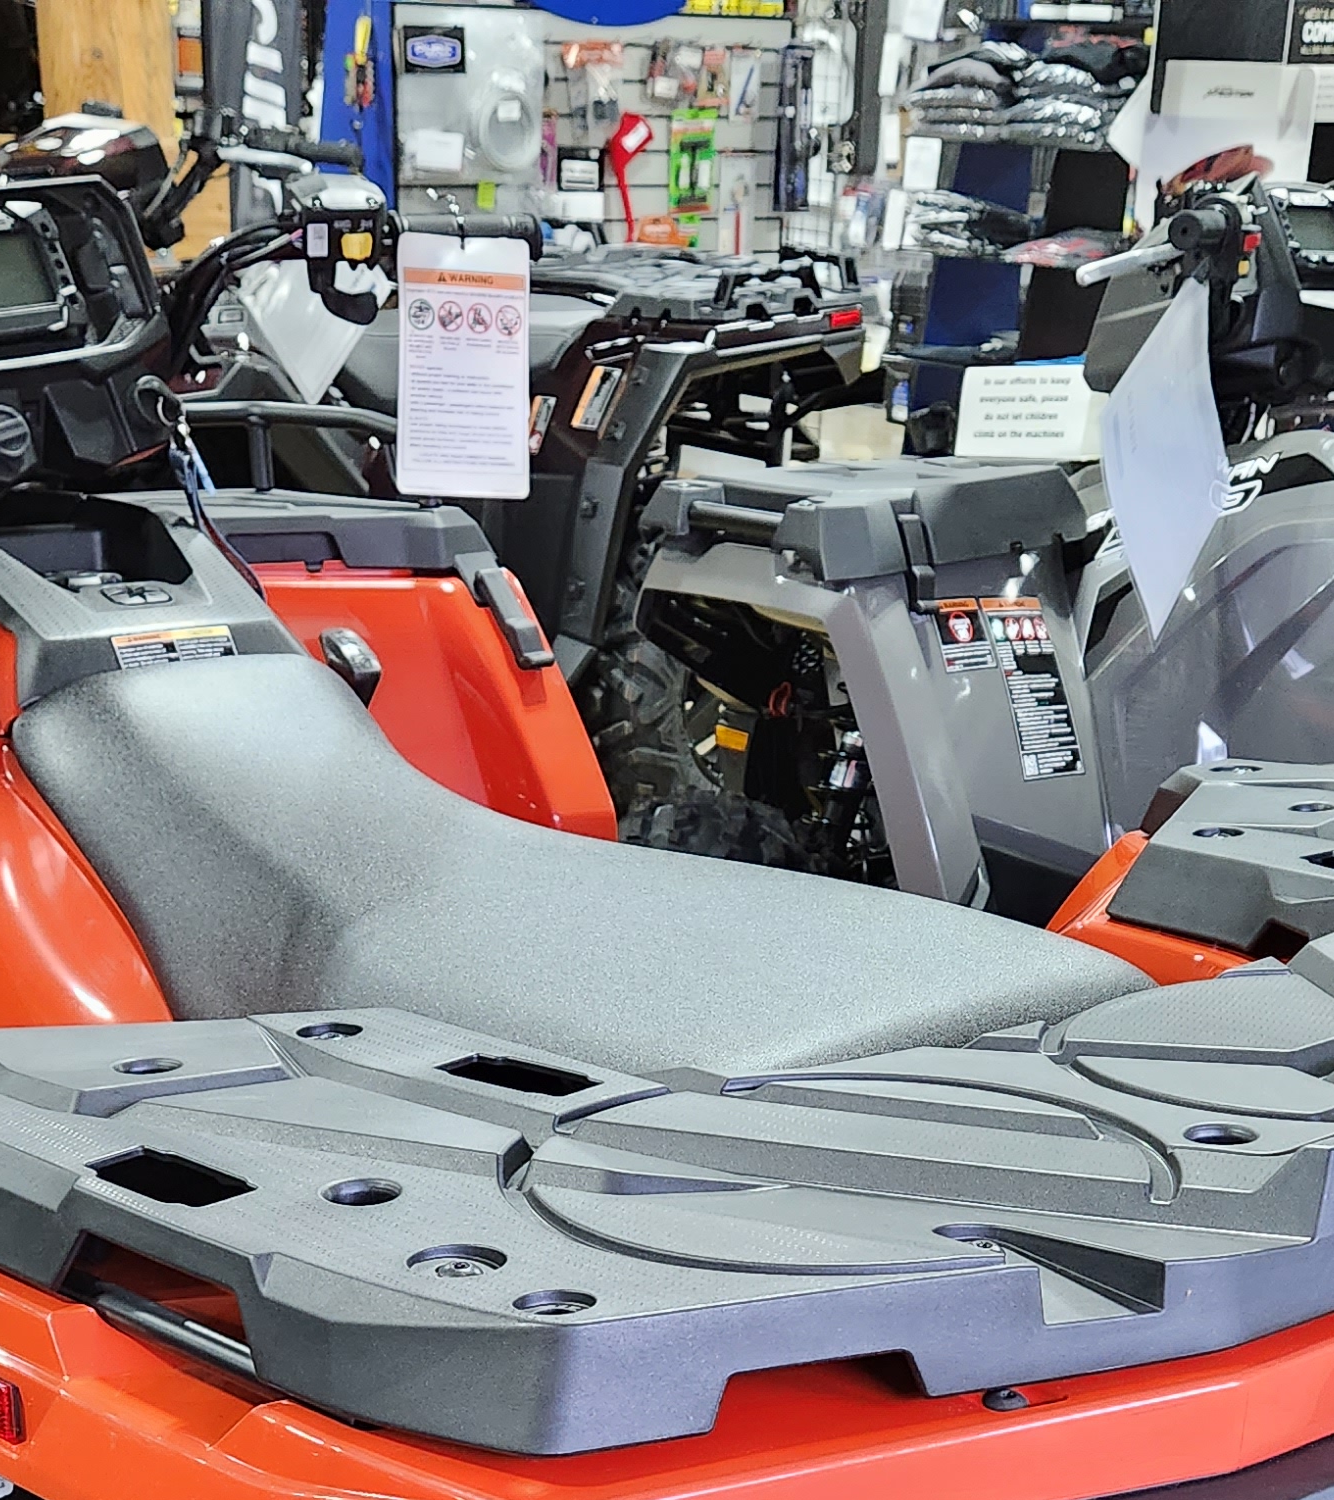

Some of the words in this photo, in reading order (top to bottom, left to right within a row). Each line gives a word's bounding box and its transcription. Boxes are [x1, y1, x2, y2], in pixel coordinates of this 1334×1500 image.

[448, 273, 494, 286] WARNING
[1009, 377, 1037, 386] efforts
[979, 395, 1017, 404] everyone
[1040, 394, 1070, 404] please
[996, 412, 1010, 421] not
[1025, 411, 1059, 421] children
[1025, 429, 1065, 438] machines
